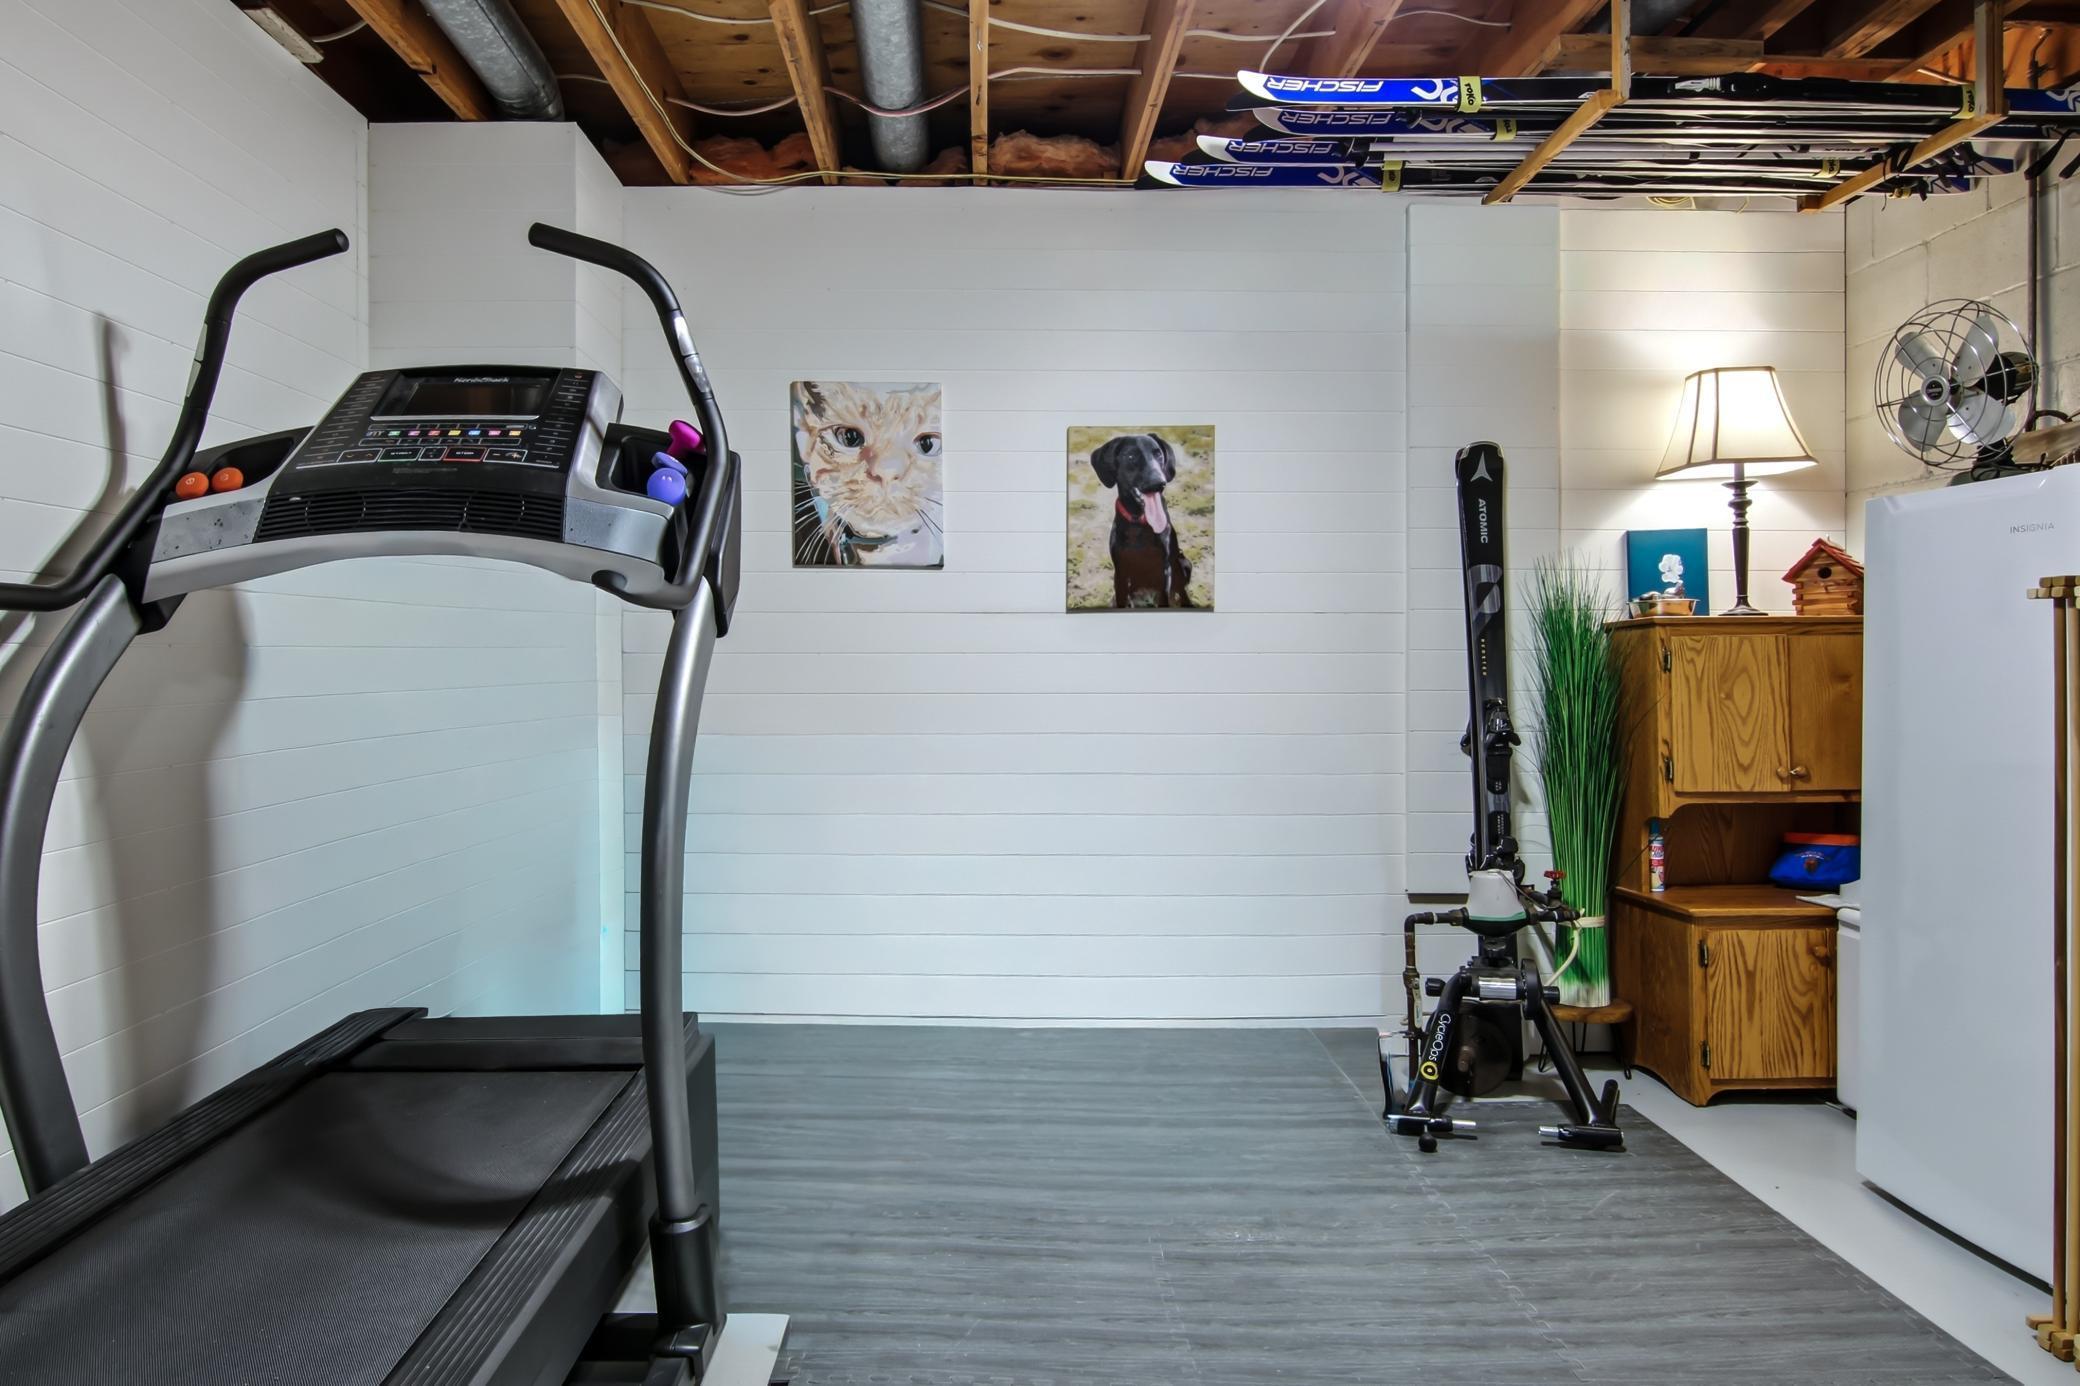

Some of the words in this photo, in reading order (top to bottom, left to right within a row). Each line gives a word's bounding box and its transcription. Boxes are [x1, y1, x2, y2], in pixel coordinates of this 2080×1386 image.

[1267, 77, 1384, 93] FISCHER
[1281, 111, 1392, 125] FISCHER
[1228, 139, 1333, 154] FISCHER
[1172, 164, 1274, 177] FISCHER
[1478, 498, 1489, 544] ATOMIC
[2009, 522, 2055, 534] INSIGNIA
